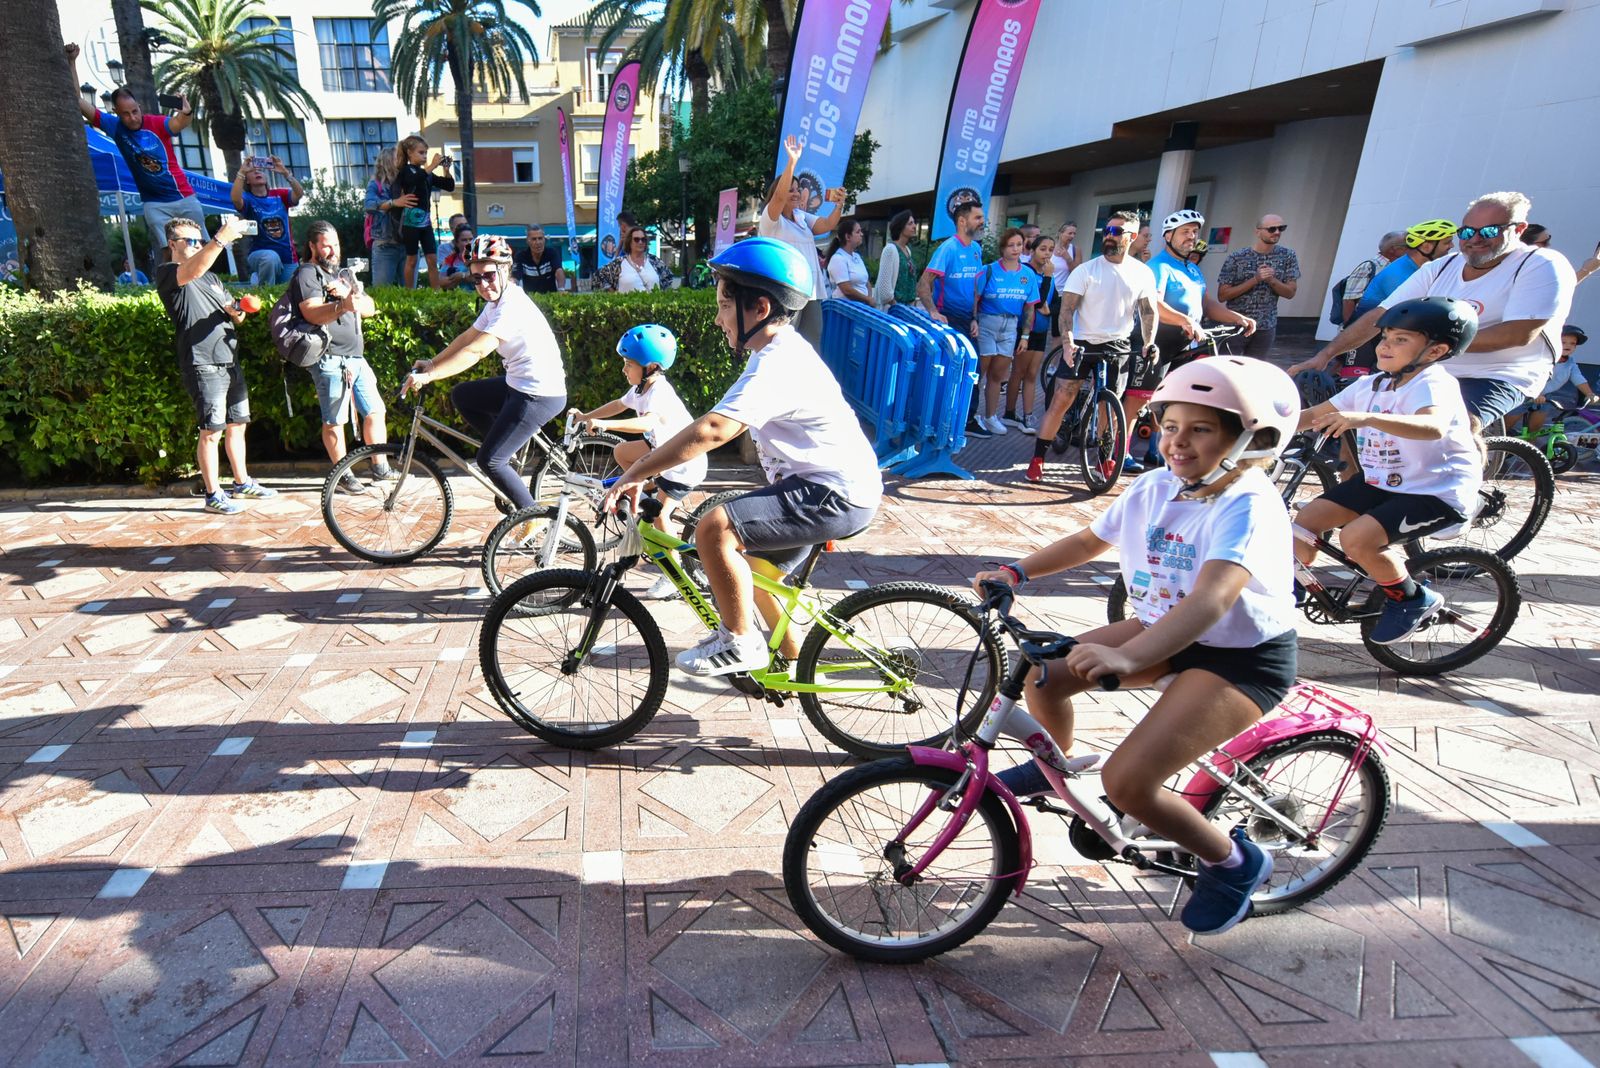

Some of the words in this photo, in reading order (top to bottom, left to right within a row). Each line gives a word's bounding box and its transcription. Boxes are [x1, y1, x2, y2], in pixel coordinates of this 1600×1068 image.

[804, 54, 827, 103] MTB
[978, 18, 1022, 133] ENMONAOS
[797, 112, 813, 149] C.D.
[809, 99, 841, 157] LOS
[961, 107, 978, 141] MTB
[609, 121, 626, 198] ENMONAOS
[955, 146, 970, 172] C.D.
[969, 138, 992, 177] LOS
[1165, 532, 1174, 541] de
[1175, 533, 1184, 543] la
[1162, 554, 1193, 571] 2023
